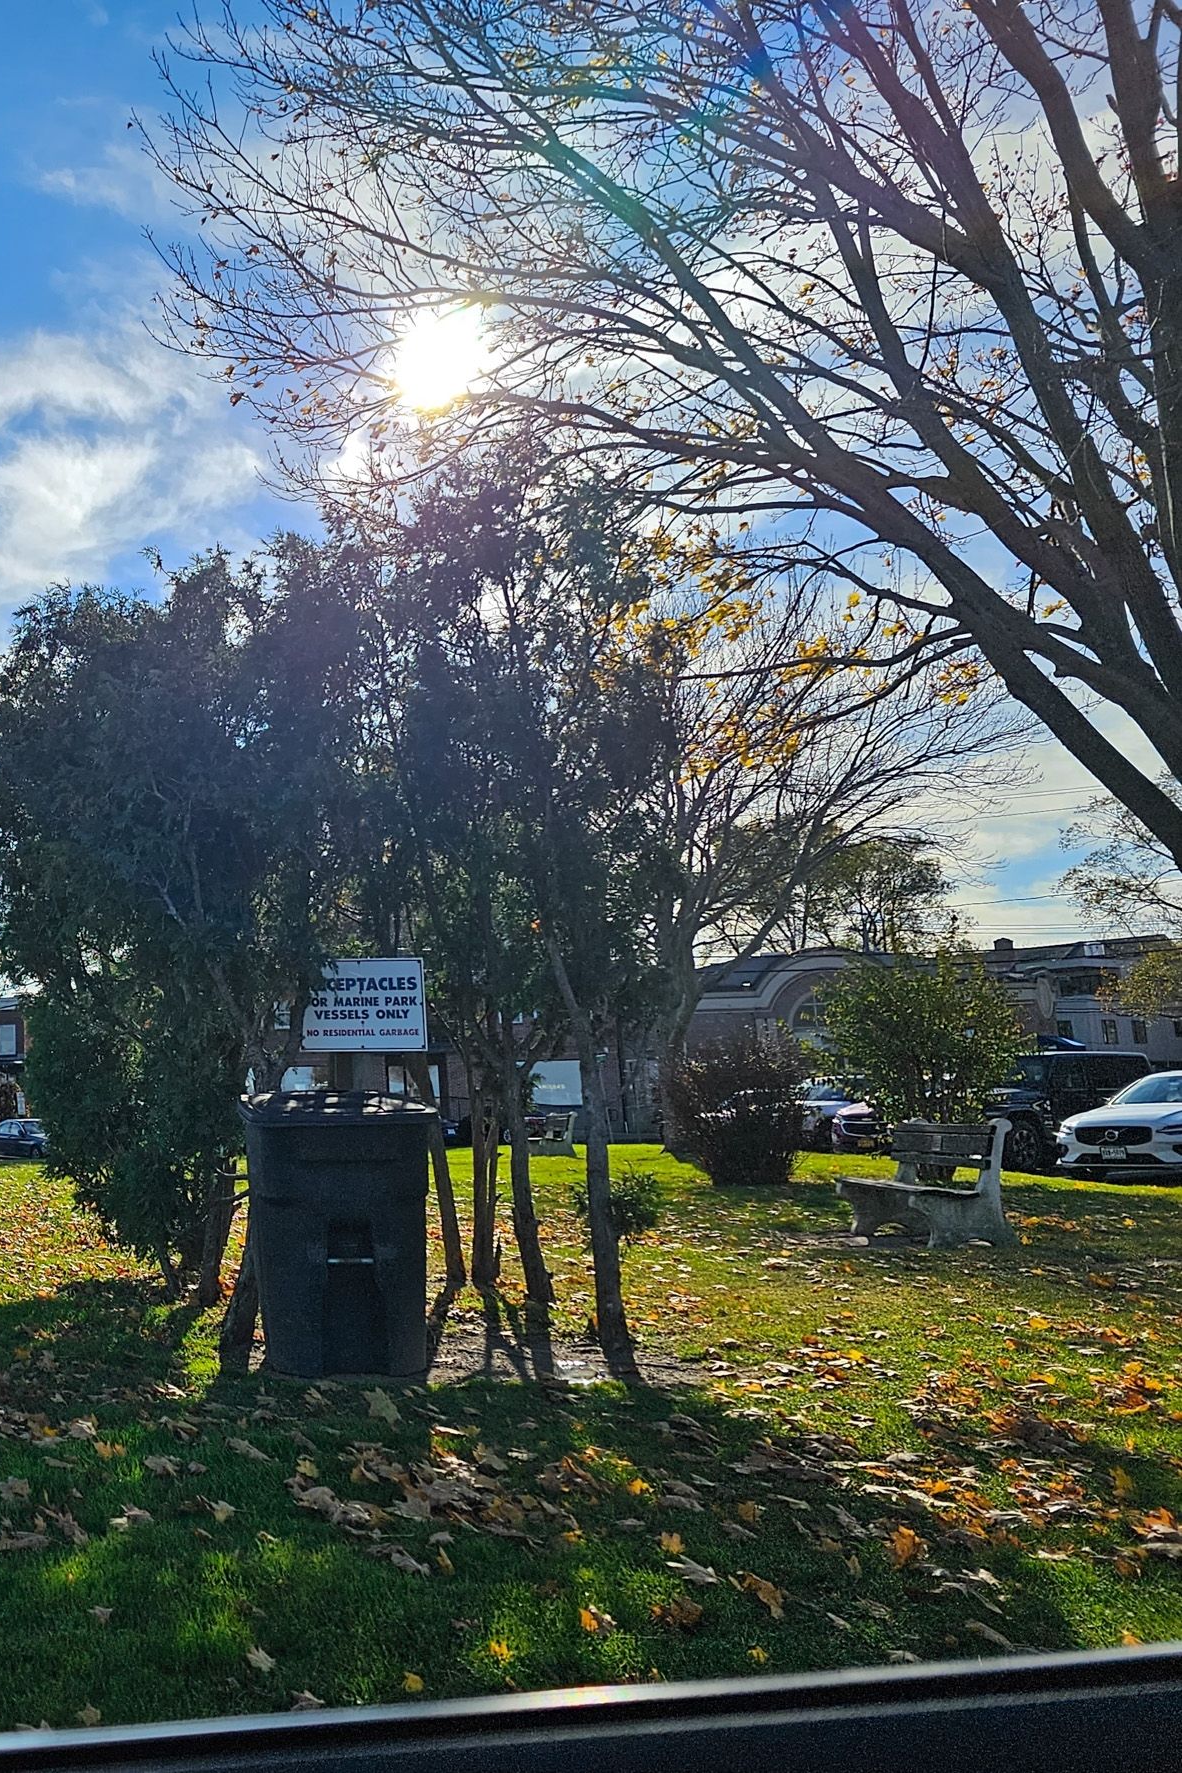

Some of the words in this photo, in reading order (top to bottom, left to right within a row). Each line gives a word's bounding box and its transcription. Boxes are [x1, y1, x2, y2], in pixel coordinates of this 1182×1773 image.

[319, 976, 418, 992] CEPTACLES
[309, 997, 328, 1008] OR
[333, 996, 380, 1007] MARINE
[384, 996, 418, 1007] PARK
[314, 1009, 370, 1020] VESSELS
[375, 1009, 410, 1020] ONLY
[306, 1029, 320, 1037] NO
[322, 1029, 376, 1037] RESIDENTIAL
[379, 1028, 420, 1036] GARBAGE
